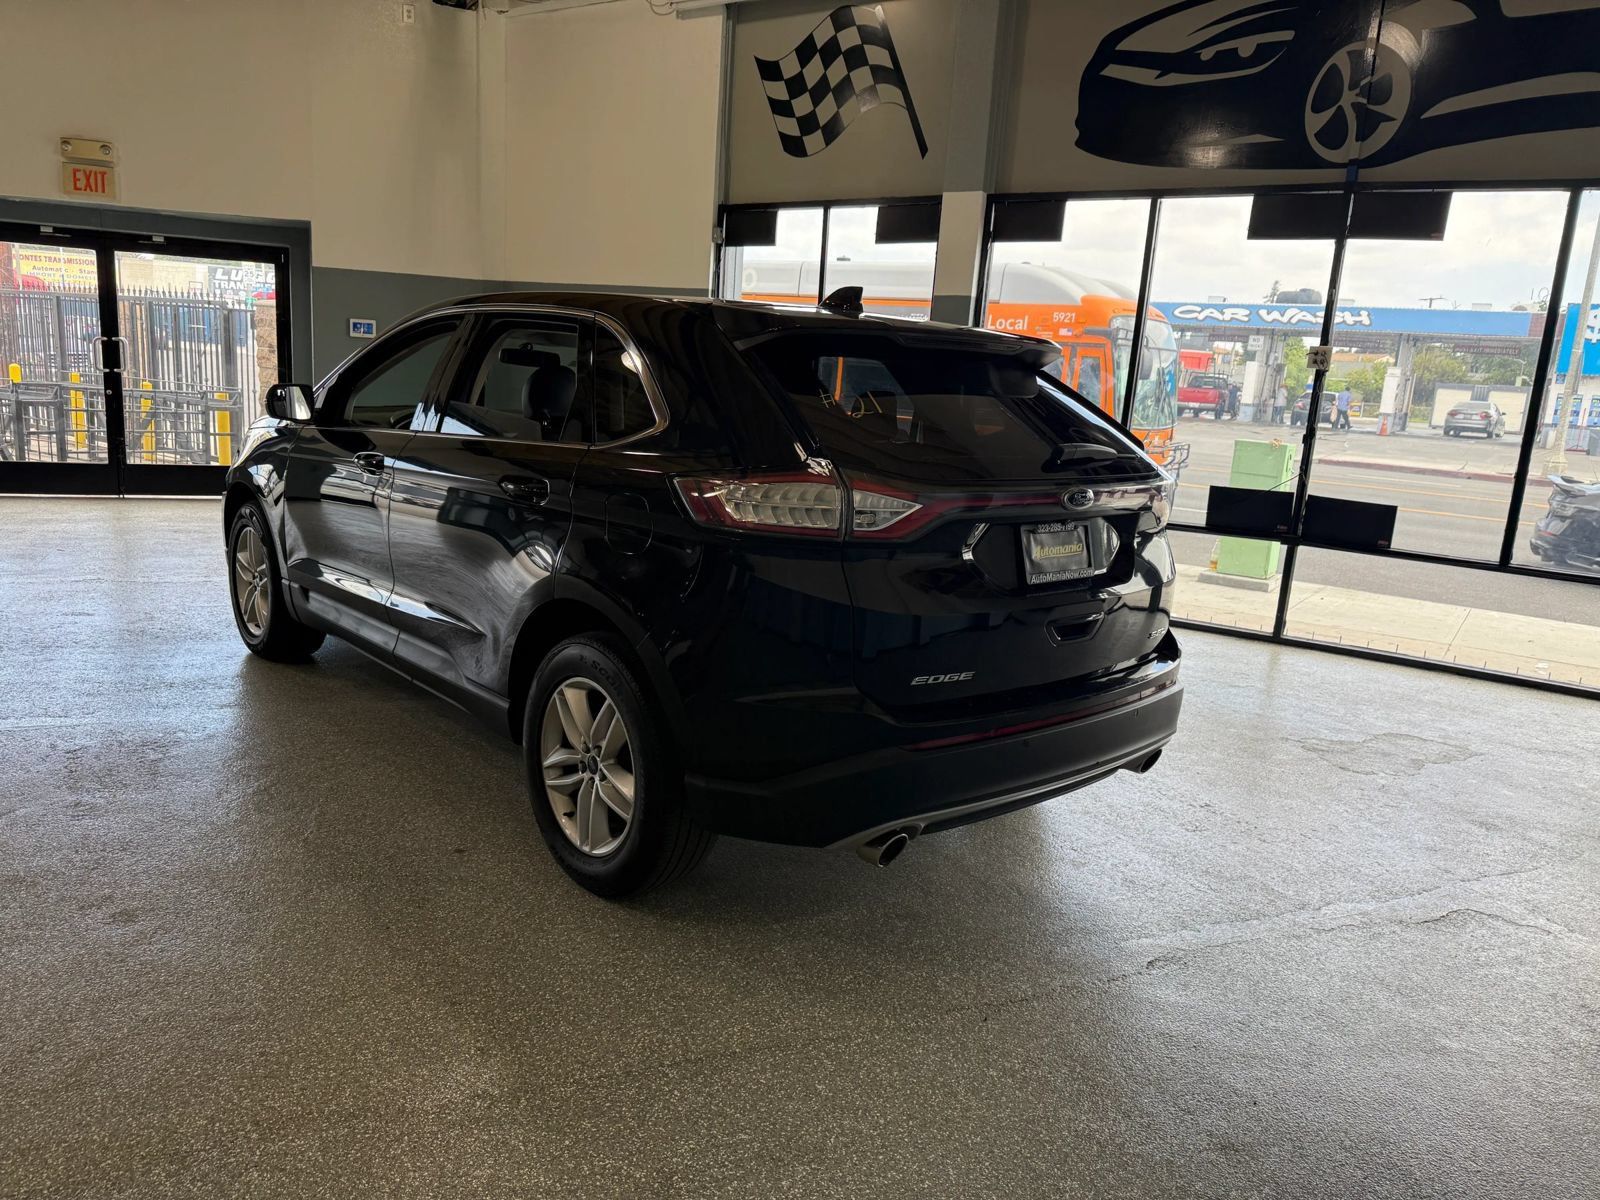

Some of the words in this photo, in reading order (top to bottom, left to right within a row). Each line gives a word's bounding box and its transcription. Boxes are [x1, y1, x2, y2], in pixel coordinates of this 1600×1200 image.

[72, 167, 107, 194] EXIT
[32, 265, 69, 273] Automatc
[1052, 311, 1077, 323] 5921
[1173, 305, 1250, 321] CAR
[987, 313, 1029, 331] Local
[1035, 544, 1083, 560] Automania
[1031, 570, 1094, 584] AutoManiaNow.com
[911, 671, 976, 686] EDGE
